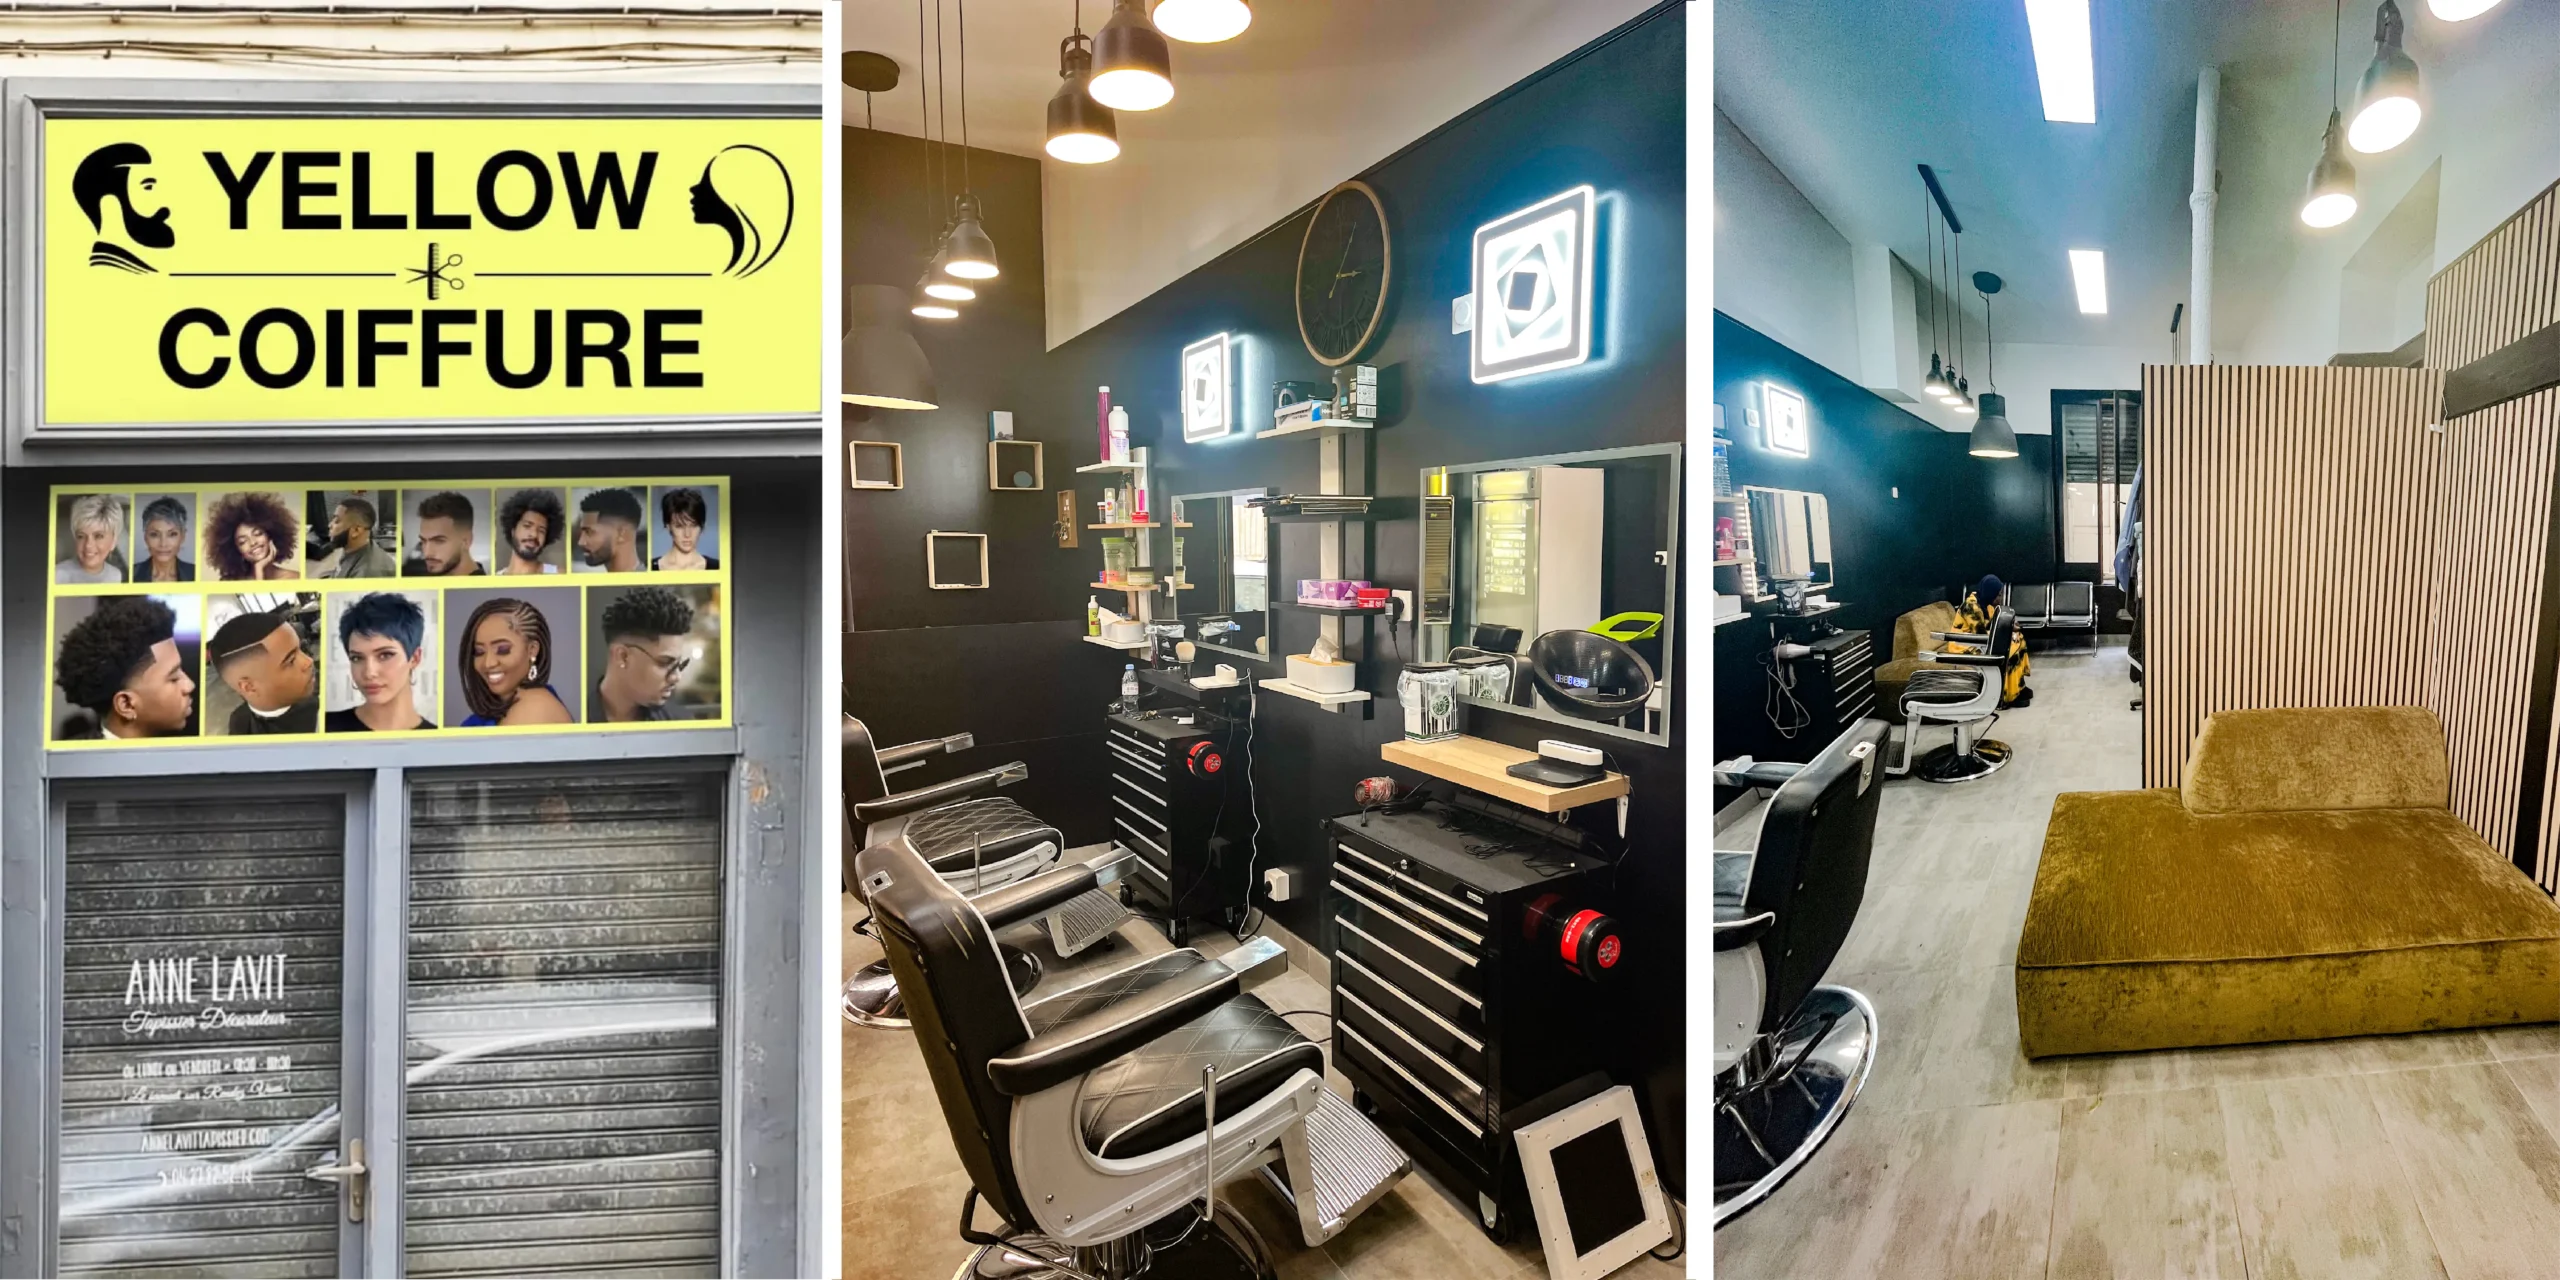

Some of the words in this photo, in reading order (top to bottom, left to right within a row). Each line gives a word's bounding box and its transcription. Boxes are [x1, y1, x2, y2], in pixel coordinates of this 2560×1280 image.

[203, 151, 659, 231] YELLOW
[158, 307, 704, 389] COIFFURE
[125, 957, 199, 1005] ANNE
[212, 954, 287, 1001] LAVIT
[123, 1010, 196, 1036] Tapissier
[200, 1007, 287, 1030] Décorateur
